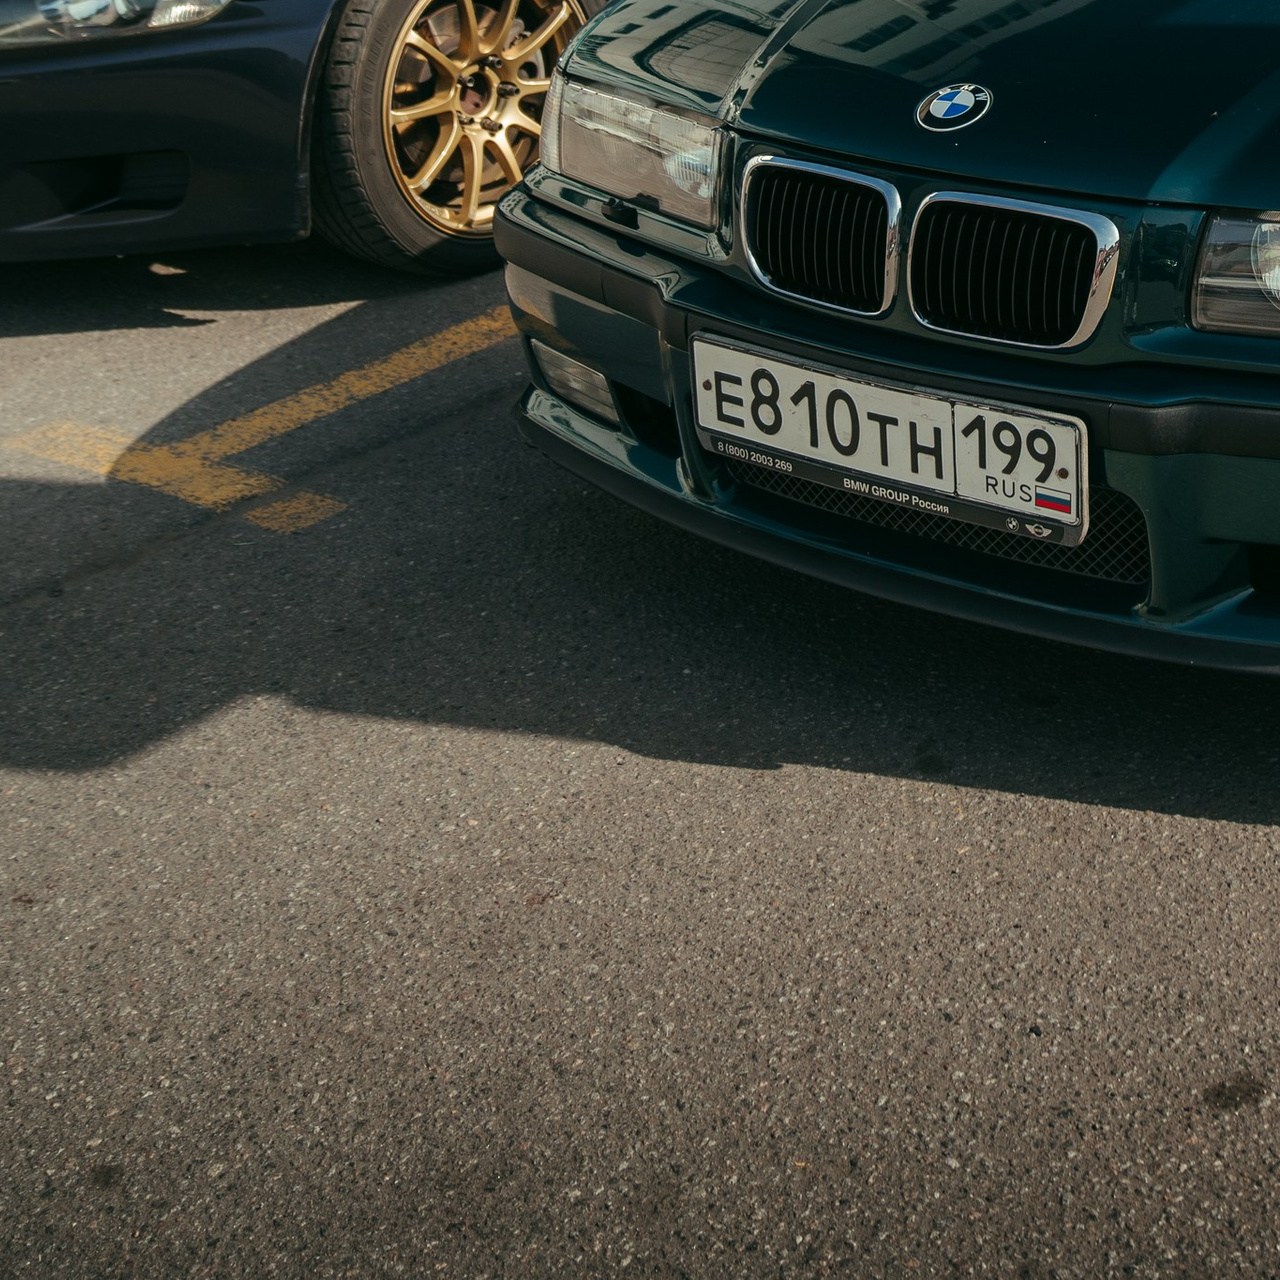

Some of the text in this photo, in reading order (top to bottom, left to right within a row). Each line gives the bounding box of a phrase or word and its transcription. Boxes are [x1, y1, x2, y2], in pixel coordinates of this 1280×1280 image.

[717, 441, 793, 472] 8 (800) 2003 269
[961, 414, 1056, 483] 199
[843, 477, 949, 514] BMW GROUP Россия
[985, 474, 1032, 503] RUS
